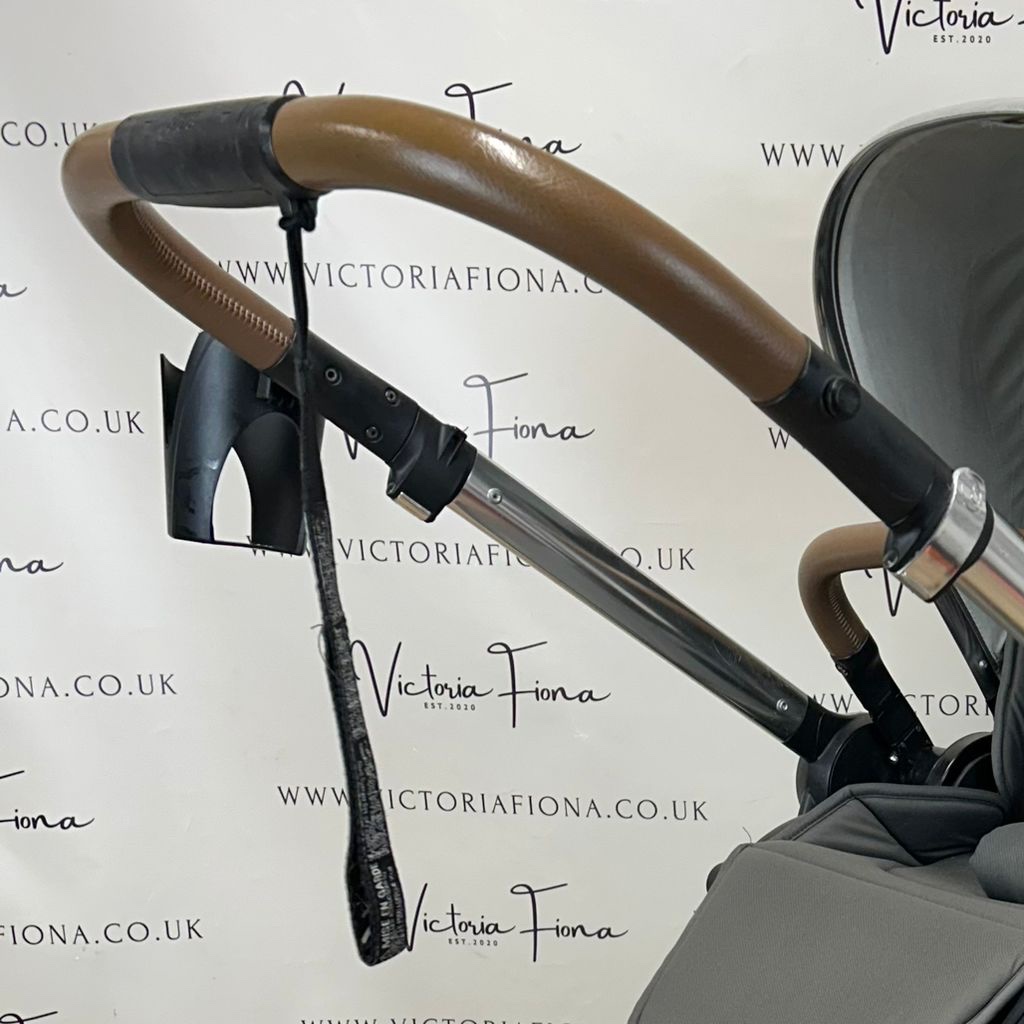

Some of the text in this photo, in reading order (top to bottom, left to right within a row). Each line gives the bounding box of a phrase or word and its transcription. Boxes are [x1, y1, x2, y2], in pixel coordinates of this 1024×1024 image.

[933, 35, 992, 43] EST.2020
[7, 409, 144, 434] A.CO.UK
[350, 640, 493, 717] Victoria
[487, 641, 611, 728] Fiona
[424, 702, 476, 711] EST.2020
[510, 883, 629, 962] Fiona
[448, 938, 498, 946] EST.2020
